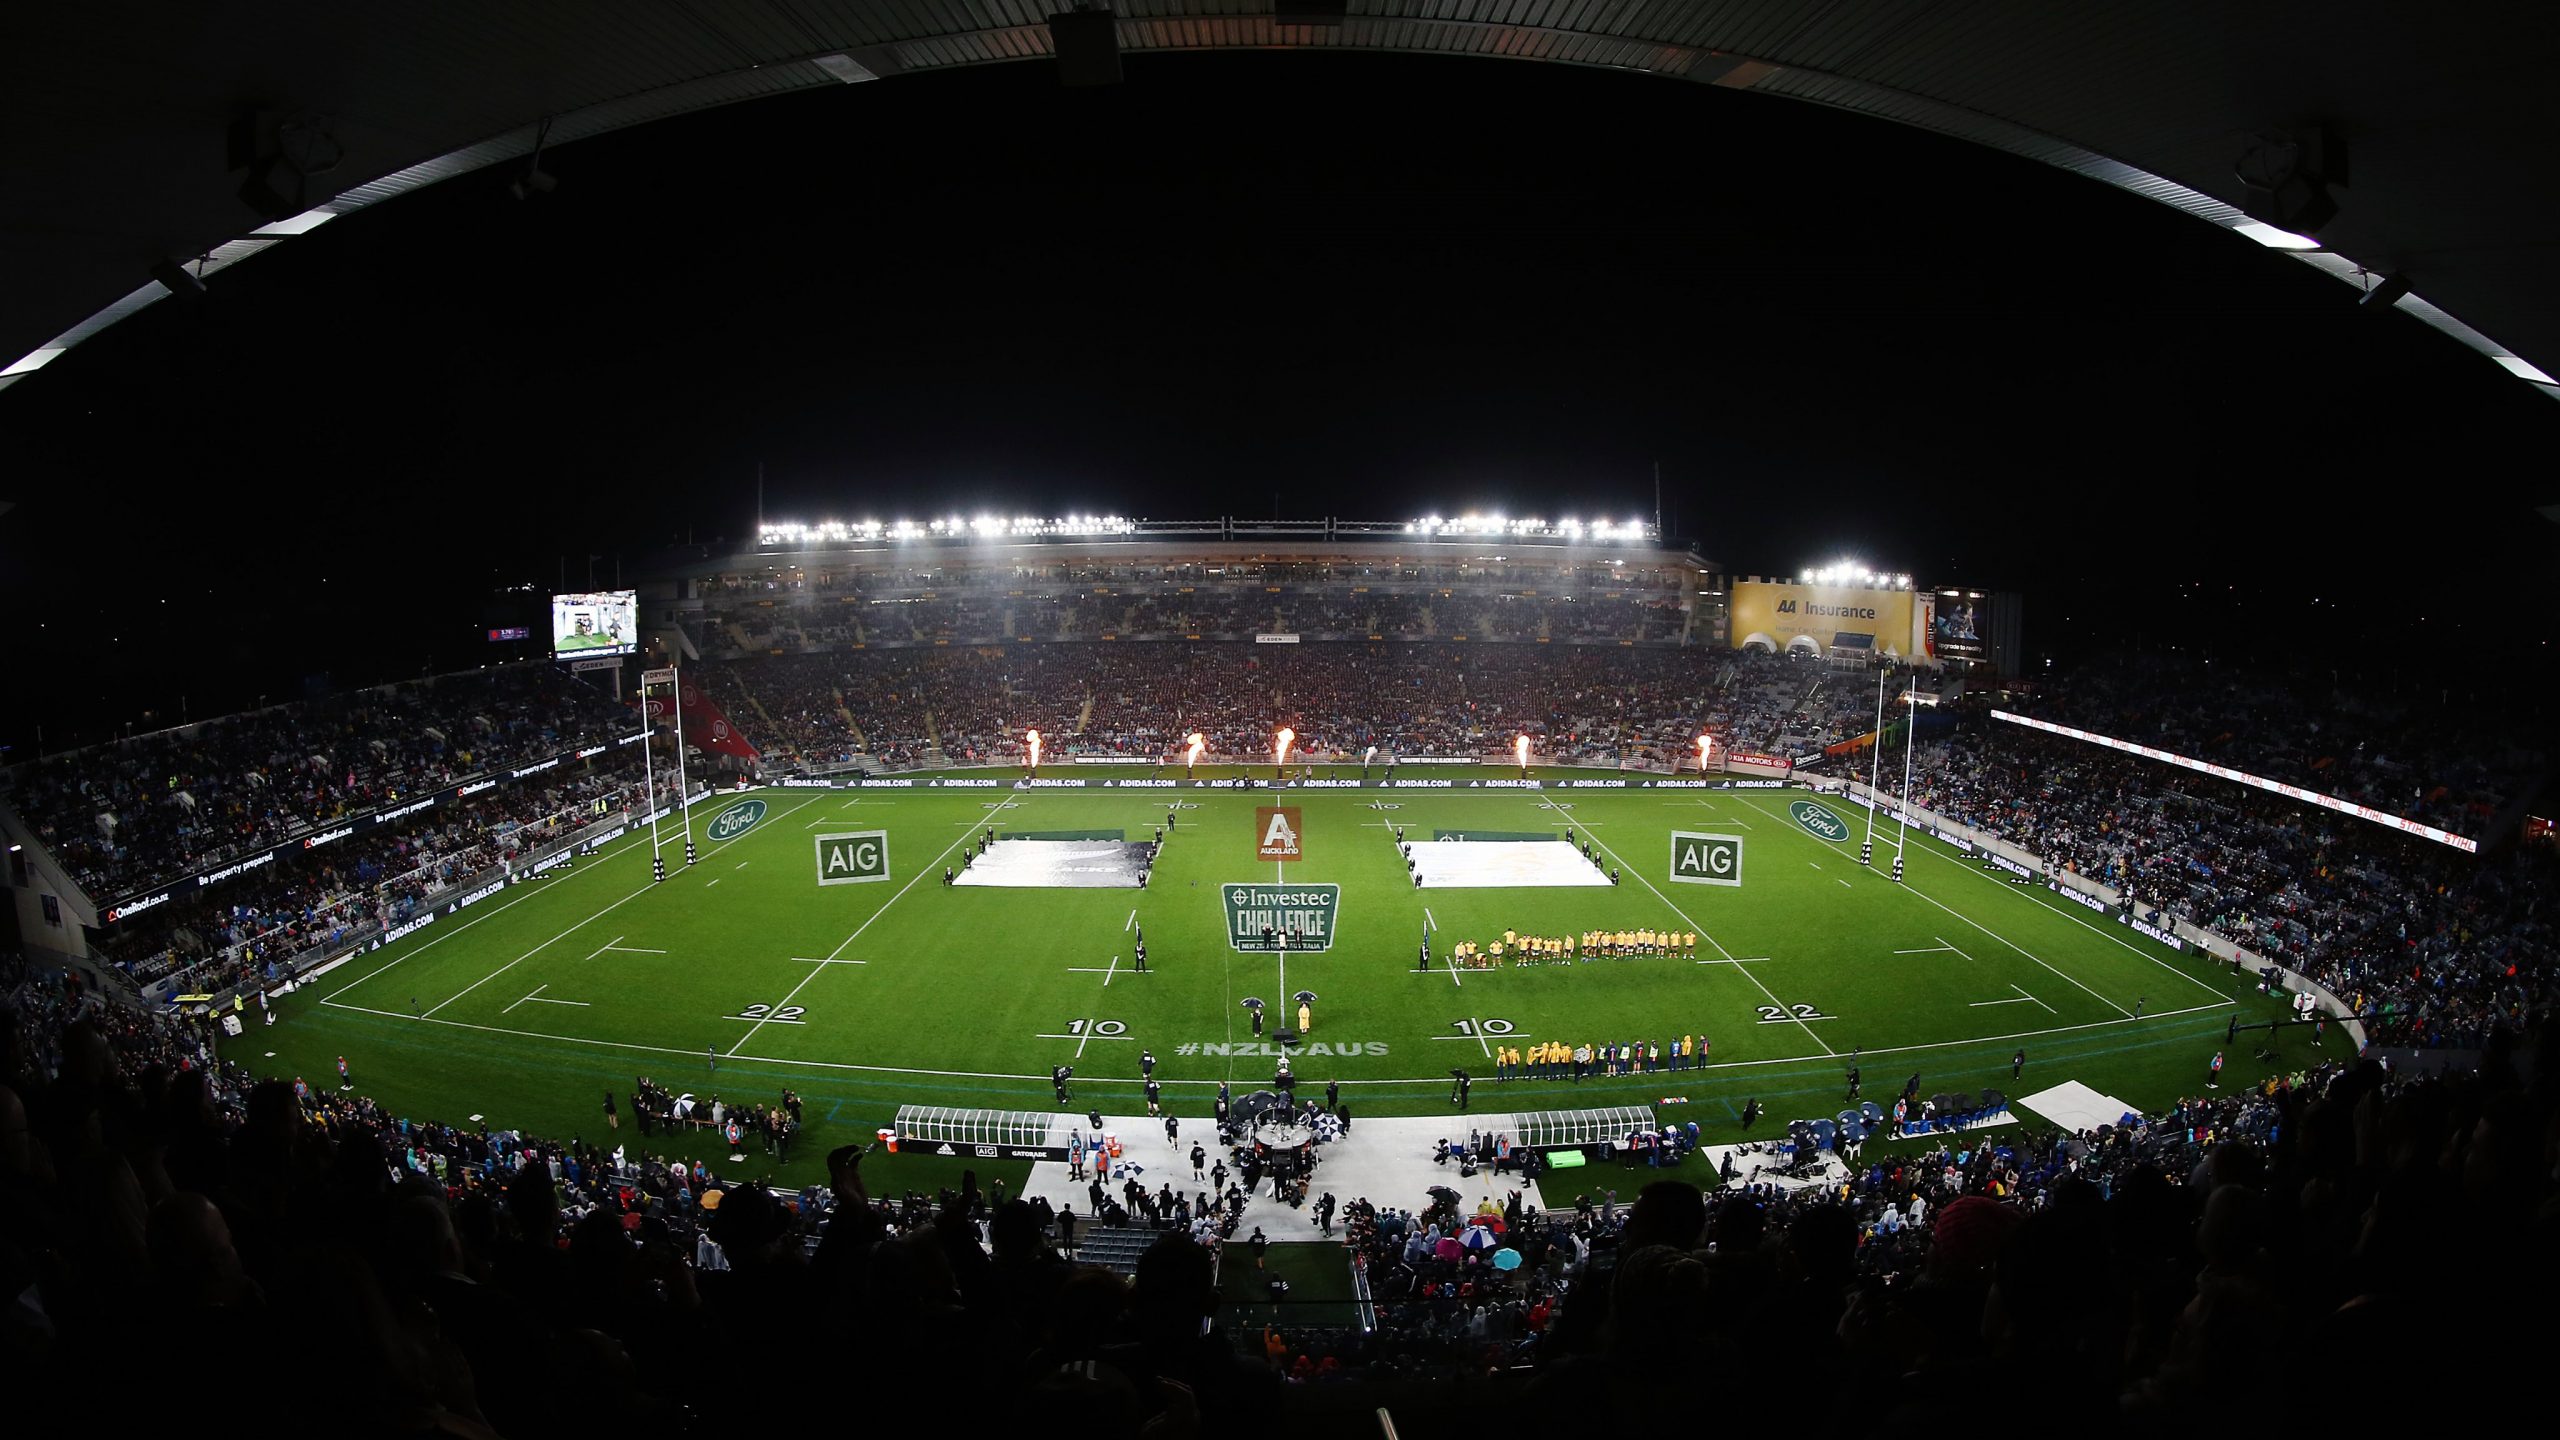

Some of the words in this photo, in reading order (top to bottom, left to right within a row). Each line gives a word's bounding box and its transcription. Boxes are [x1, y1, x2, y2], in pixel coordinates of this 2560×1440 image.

[1777, 600, 1796, 613] AA
[1805, 601, 1875, 619] Insurance
[2055, 725, 2073, 736] STIHL
[2082, 732, 2100, 743] STIHL
[2111, 739, 2131, 751] STIHL
[2141, 747, 2161, 759] STIHL
[1745, 756, 1772, 766] MOTORS
[1795, 752, 1822, 766] Resene
[2172, 754, 2194, 768] STIHL
[2205, 764, 2229, 777] STIHL
[463, 779, 496, 796] OneRoof.co.nz
[783, 779, 831, 787] ADIDAS.COM
[861, 779, 912, 787] ADIDAS.COM
[943, 779, 997, 787] ADIDAS.COM
[1030, 779, 1085, 787] ADIDAS.COM
[1119, 779, 1176, 787] ADIDAS.COM
[1210, 779, 1268, 787] ADIDSOM
[1303, 780, 1360, 788] ADIDAS.COM
[1395, 780, 1451, 788] ADIDAS.COM
[1485, 780, 1540, 788] ADIDAS.COM
[1572, 780, 1625, 788] ADIDAS.COM
[1656, 780, 1706, 788] ADIDAS.COM
[1735, 780, 1783, 788] ADIDAS.COM
[2240, 773, 2264, 787] STIHL
[2277, 783, 2303, 798] STIHL
[375, 813, 384, 824] Be
[384, 805, 409, 822] property
[410, 797, 434, 812] prepared
[2316, 795, 2343, 811] STIHL
[719, 806, 755, 835] Ford
[1800, 805, 1839, 836] Ford
[2357, 806, 2385, 823] STIHL
[2400, 819, 2428, 837] STIHL
[310, 827, 353, 847] OneRoof.co.nz
[591, 827, 624, 848] ADIDAS.COM
[1938, 831, 1972, 852] ADIDAS.COM
[2443, 832, 2474, 851] STIHL
[533, 850, 572, 874] ADIDAS.COM
[827, 842, 878, 873] AIG
[1680, 844, 1731, 874] AIG
[199, 875, 208, 886] Be
[210, 864, 241, 884] property
[242, 851, 273, 872] prepared
[1992, 854, 2030, 878] ADIDAS.COM
[461, 880, 504, 908] ADIDAS.COM
[1250, 888, 1330, 906] Investec
[2060, 886, 2104, 913] ADIDAS.COM
[116, 892, 169, 919] OneRoof.co.nz
[385, 912, 434, 945] ADIDAS.COM
[1237, 909, 1325, 936] CHALLENGE
[2131, 919, 2182, 950] ADIDAS.COM
[740, 1003, 805, 1020] 22
[1757, 1004, 1821, 1019] 22
[1067, 1019, 1127, 1035] 10
[1453, 1019, 1514, 1034] 10
[1012, 1150, 1047, 1158] GATORADE
